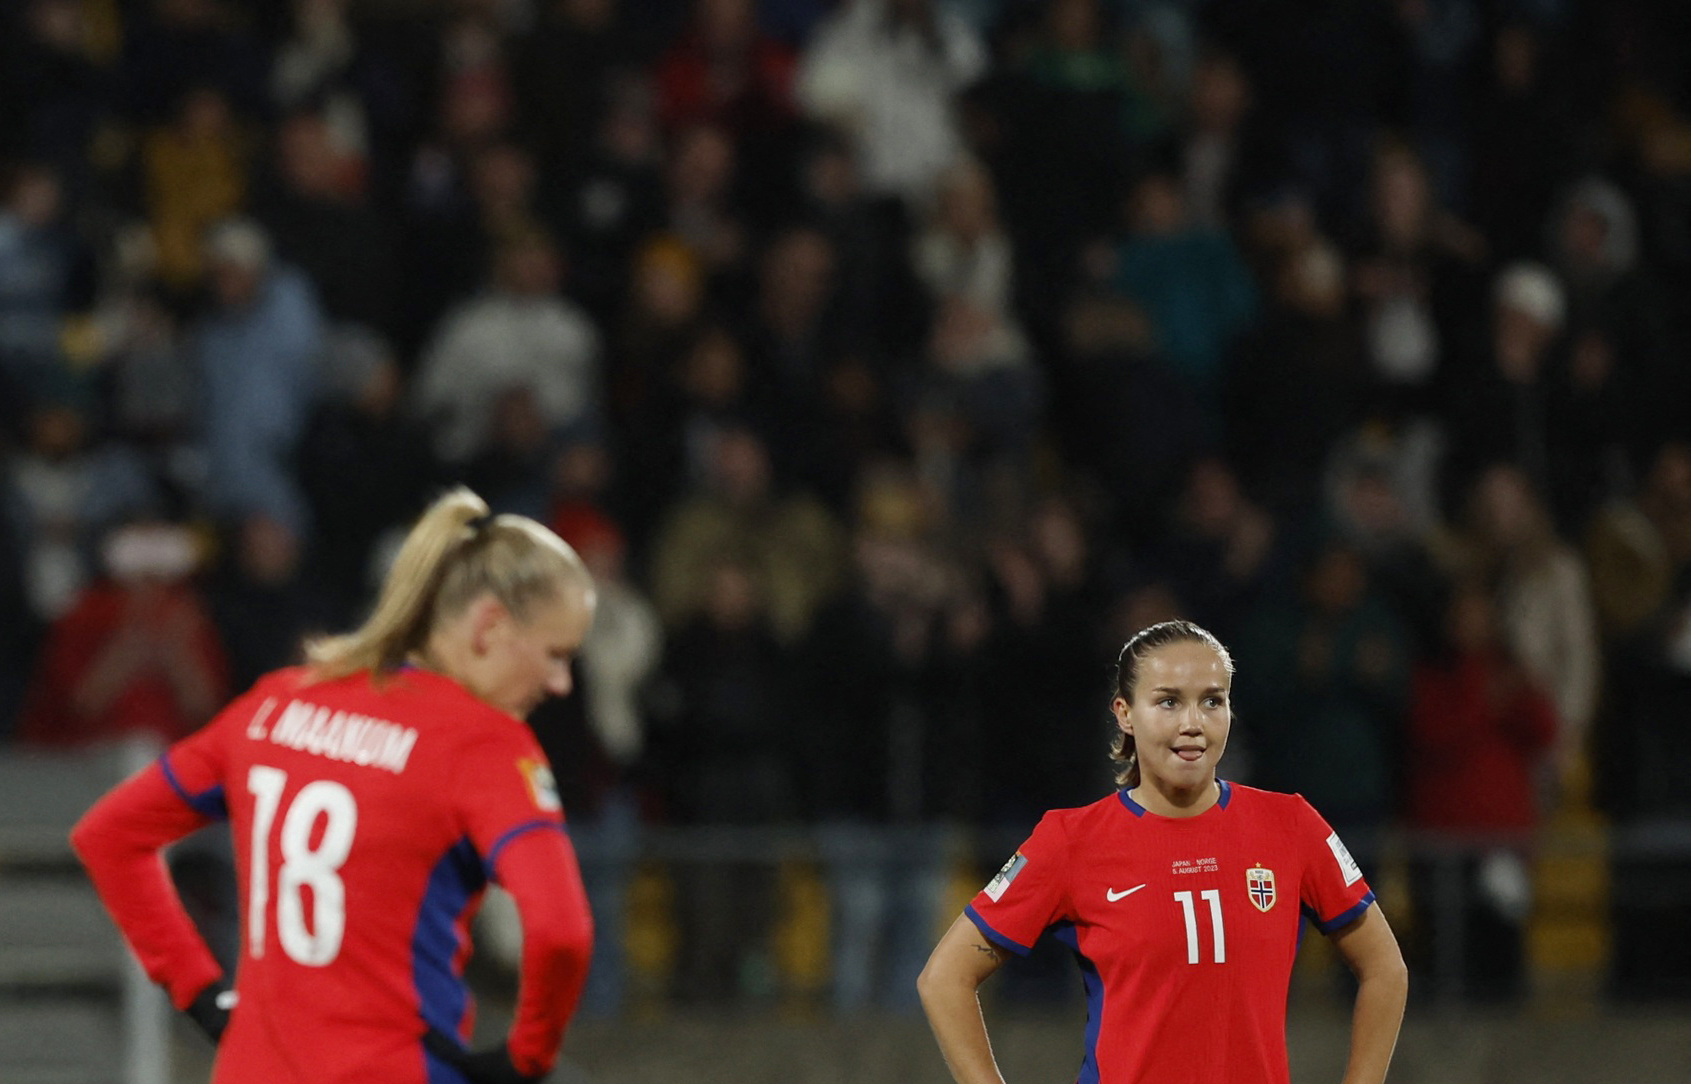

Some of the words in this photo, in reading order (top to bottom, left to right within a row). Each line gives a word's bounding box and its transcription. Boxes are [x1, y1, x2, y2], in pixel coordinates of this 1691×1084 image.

[247, 764, 357, 967] 18
[1172, 860, 1191, 868] JAPAN
[1179, 865, 1202, 875] AUGUST
[1203, 864, 1219, 873] 2023
[1173, 889, 1225, 964] 11
